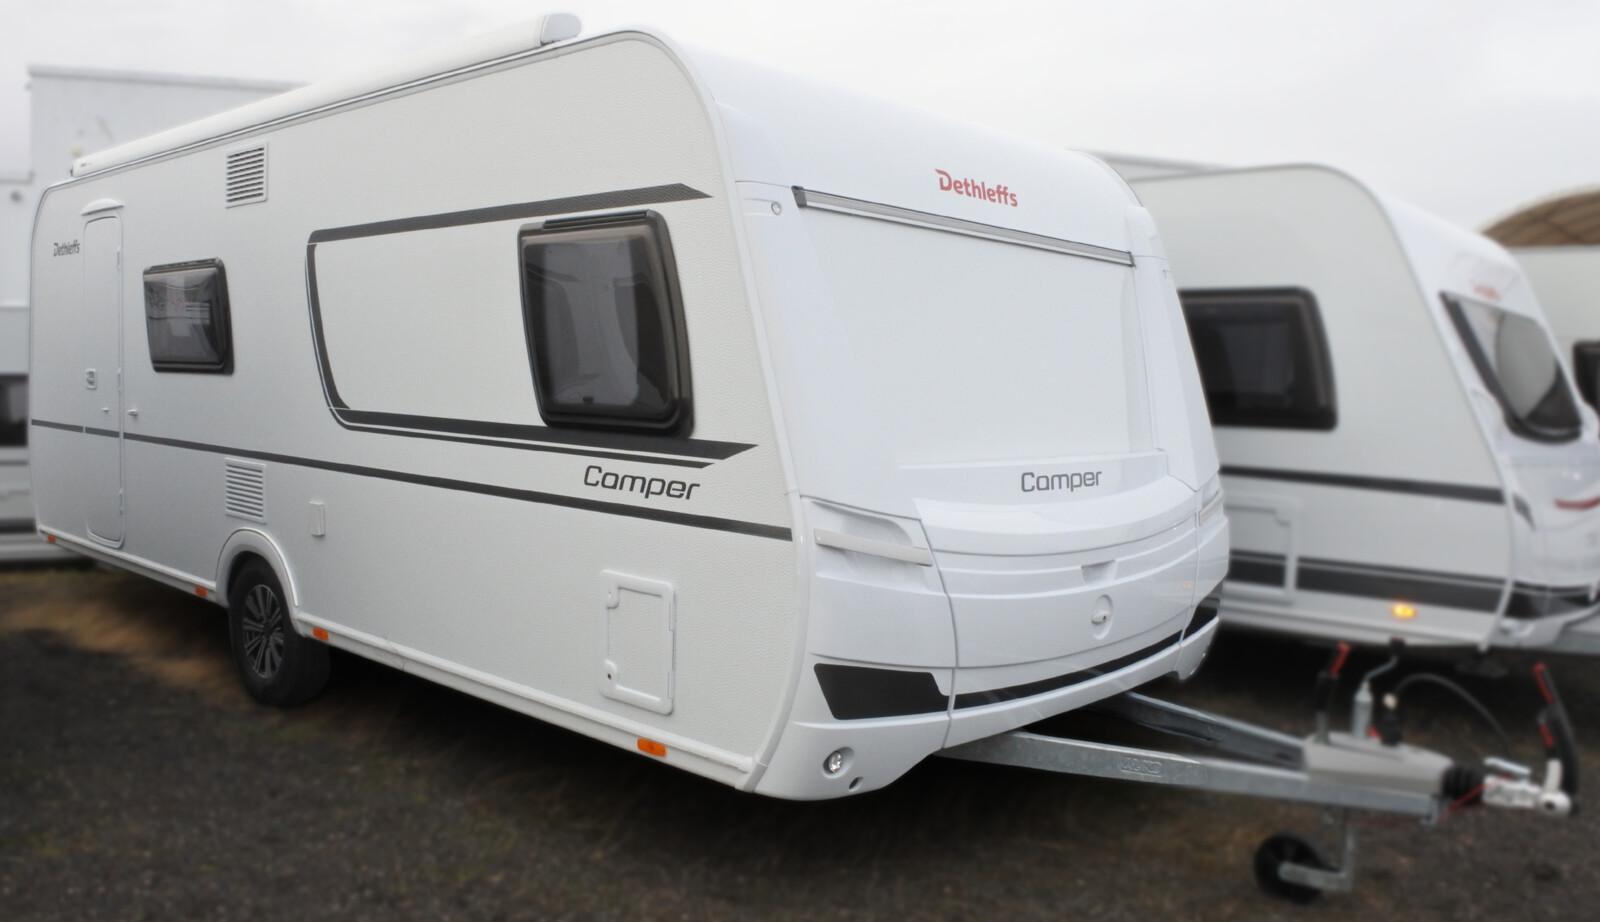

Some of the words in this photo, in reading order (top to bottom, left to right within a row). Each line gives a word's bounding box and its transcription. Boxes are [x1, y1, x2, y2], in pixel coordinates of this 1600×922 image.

[935, 168, 1018, 207] Dethleffs
[584, 465, 700, 500] Camper
[1021, 471, 1102, 492] Camper
